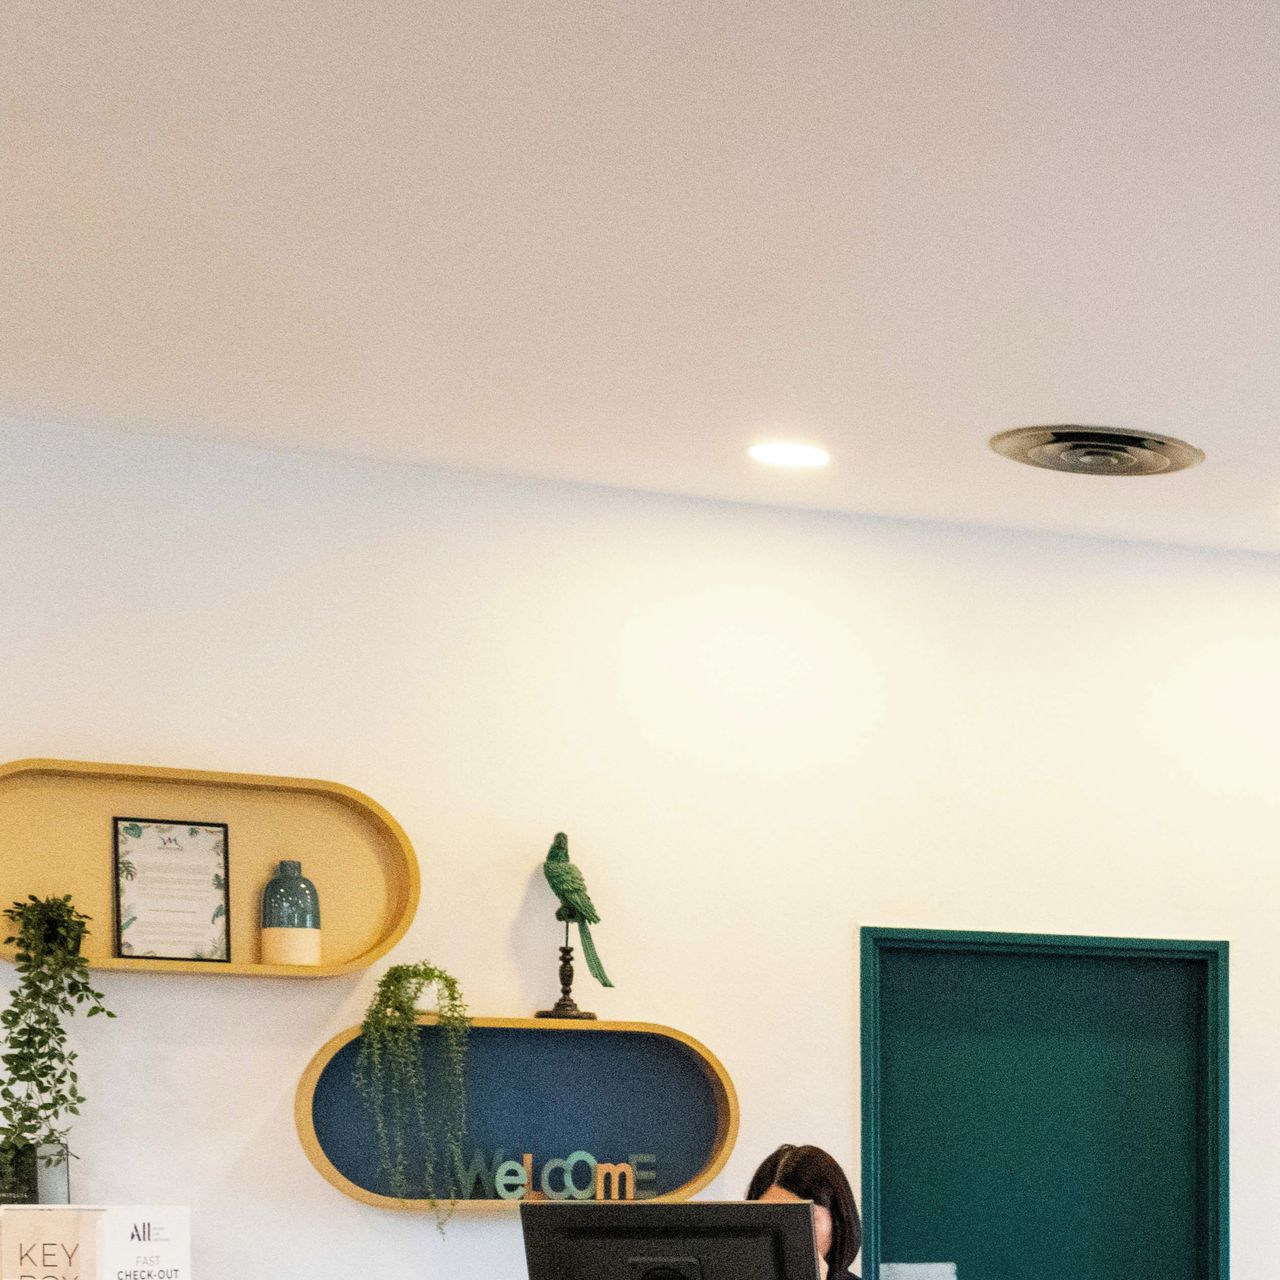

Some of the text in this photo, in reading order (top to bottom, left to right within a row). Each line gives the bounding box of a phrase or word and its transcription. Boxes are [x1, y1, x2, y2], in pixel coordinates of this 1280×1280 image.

[19, 1242, 80, 1268] KEY
[135, 1255, 161, 1267] FAST
[117, 1269, 180, 1280] CHECK-OUT
